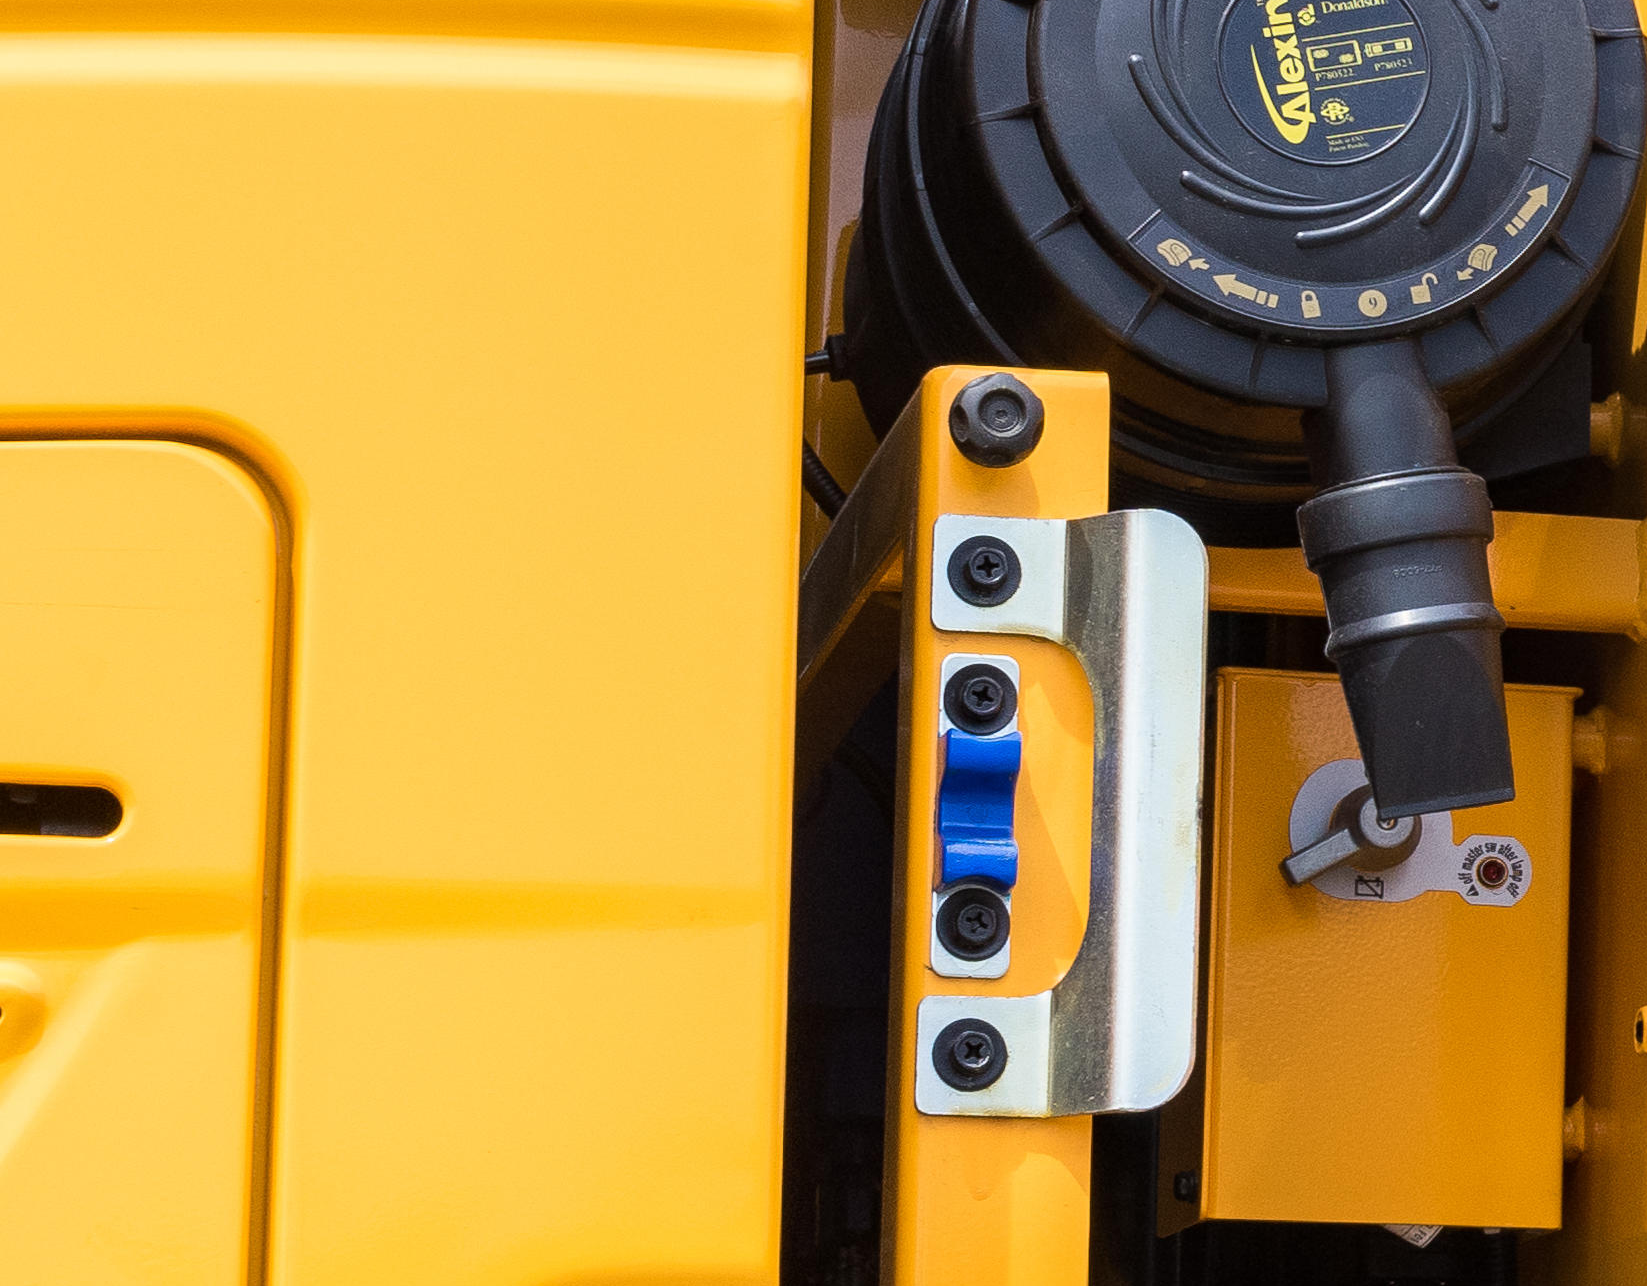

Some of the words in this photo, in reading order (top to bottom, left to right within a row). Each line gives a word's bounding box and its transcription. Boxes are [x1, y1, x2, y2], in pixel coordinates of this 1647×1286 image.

[1462, 845, 1484, 871] master
[1498, 844, 1518, 861] after
[1458, 873, 1473, 884] off
[1509, 860, 1524, 882] lamp
